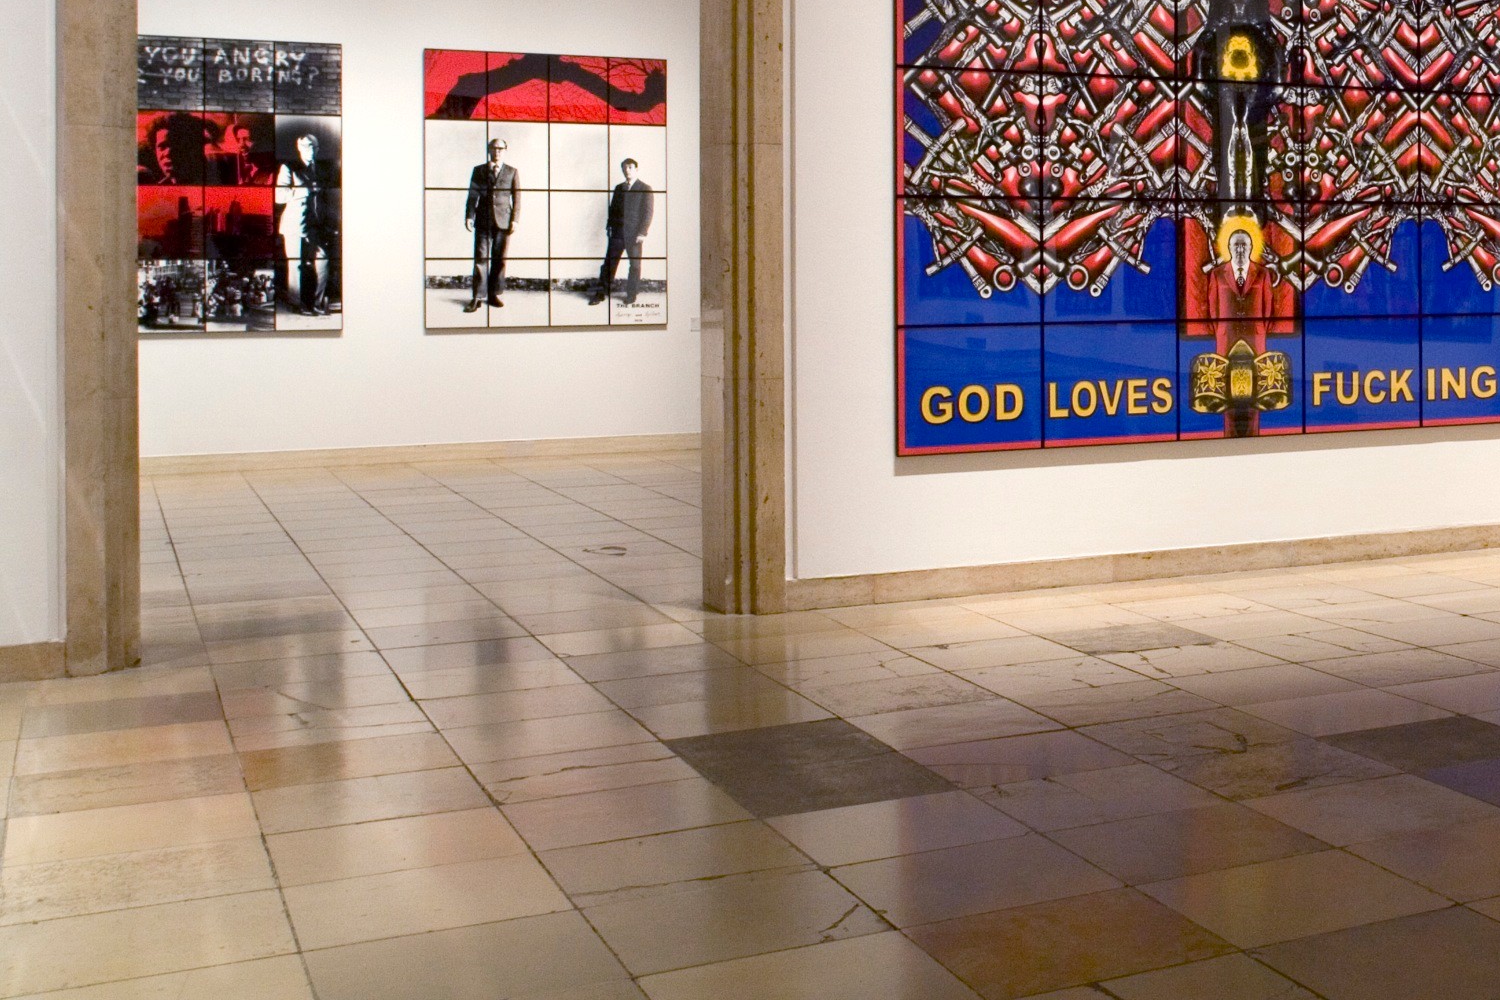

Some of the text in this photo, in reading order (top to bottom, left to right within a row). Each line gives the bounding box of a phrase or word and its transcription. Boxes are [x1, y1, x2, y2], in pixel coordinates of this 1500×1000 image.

[144, 46, 305, 68] YOU ANGRY
[920, 383, 1025, 425] GOD
[1048, 376, 1174, 419] LOVES
